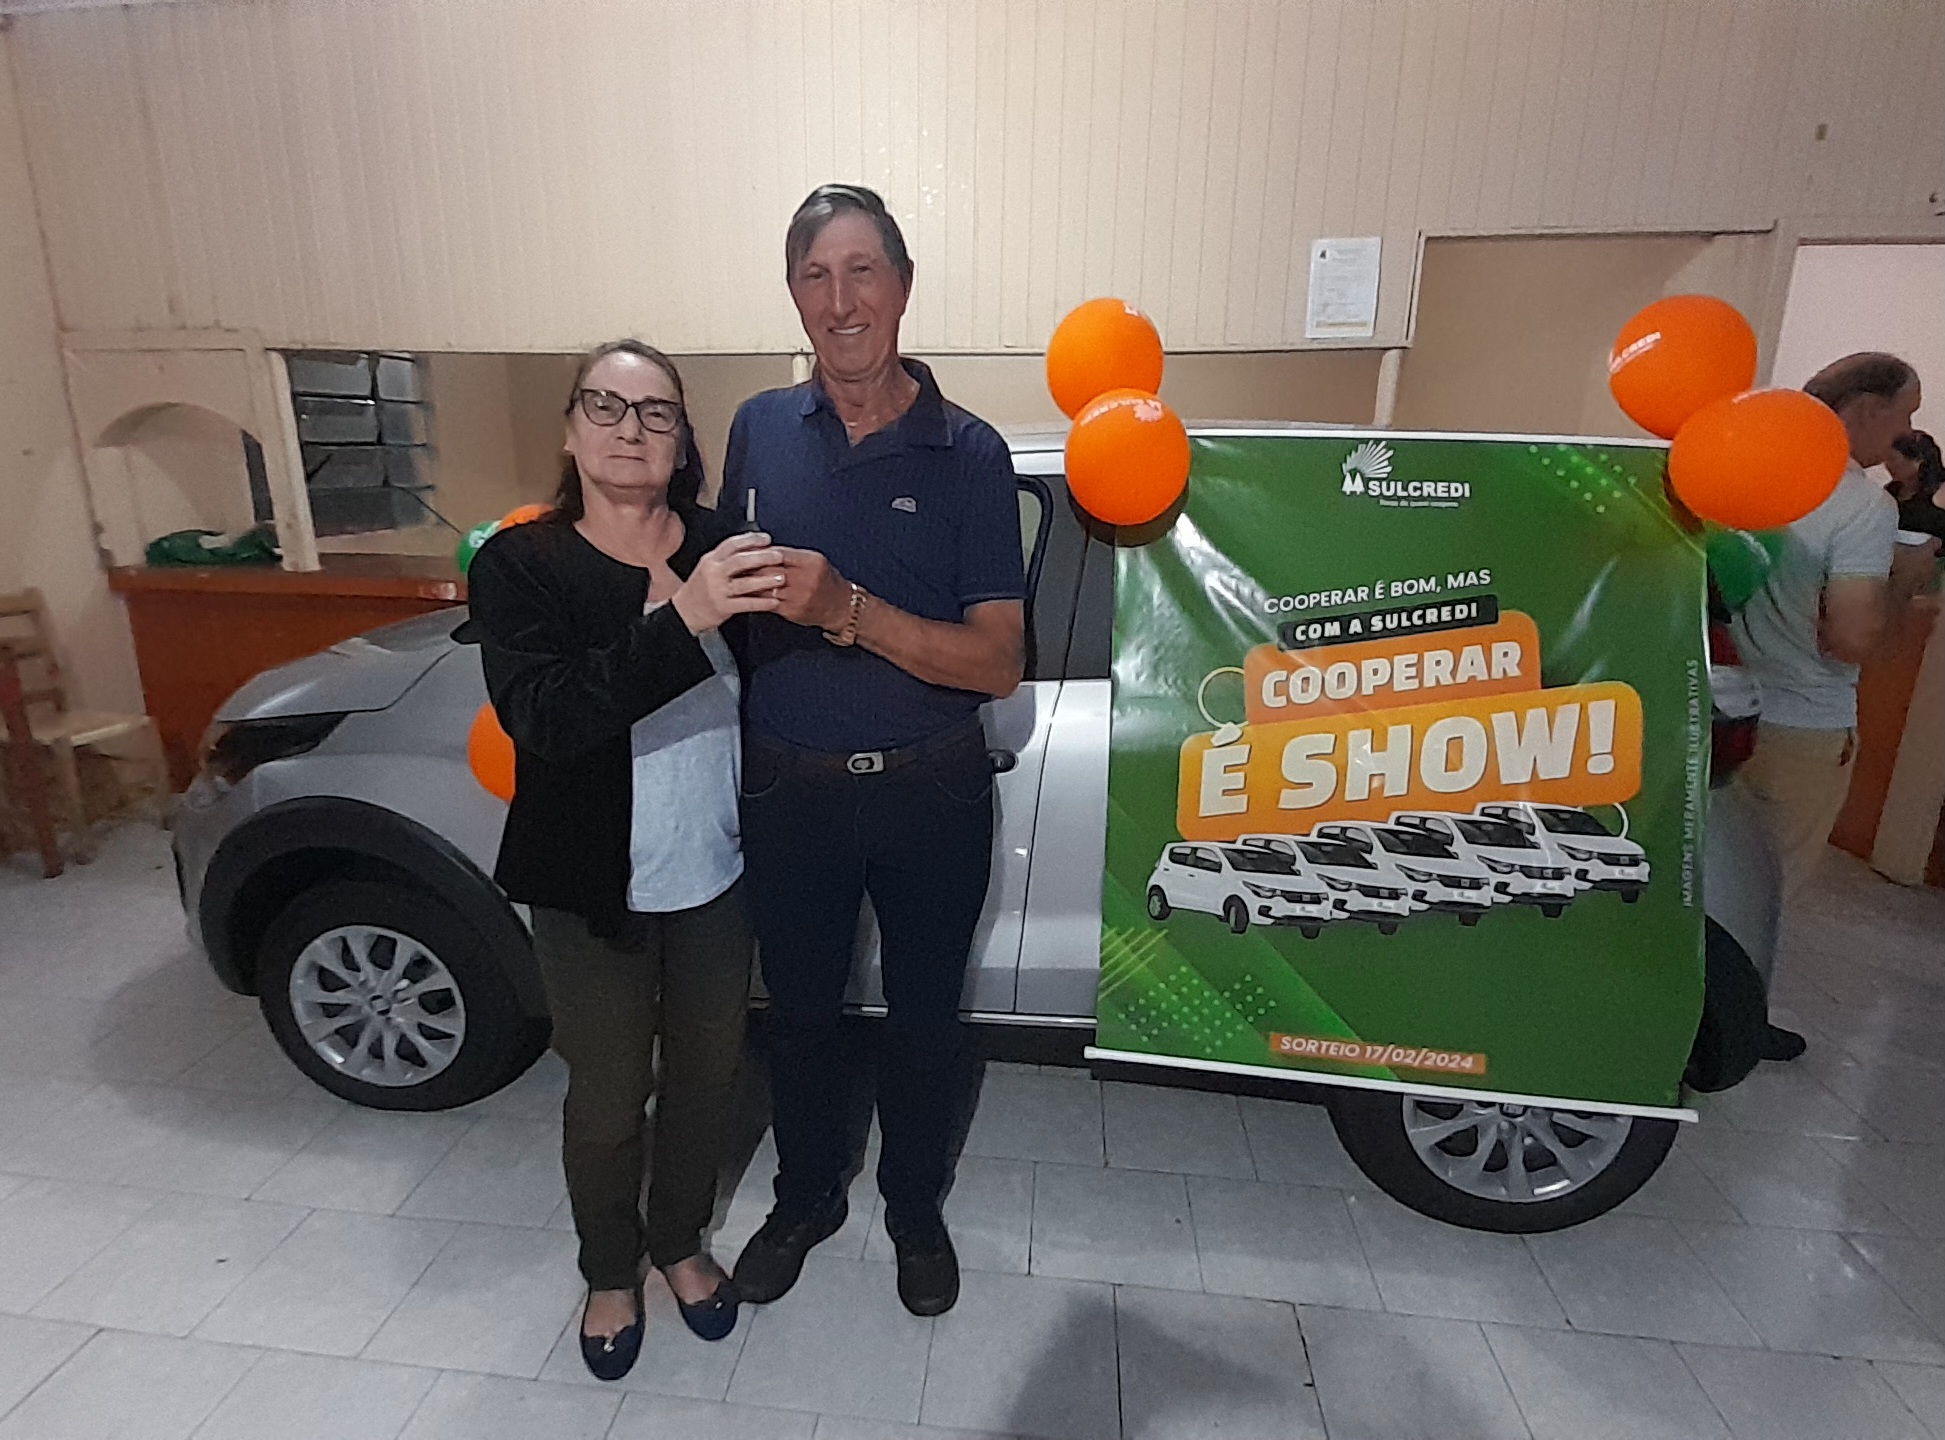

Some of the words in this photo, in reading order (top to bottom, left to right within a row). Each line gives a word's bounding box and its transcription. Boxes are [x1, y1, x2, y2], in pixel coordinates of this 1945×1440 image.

[1367, 480, 1471, 498] SULCREDI
[1264, 586, 1369, 614] COOPERAR
[1374, 580, 1386, 600] É
[1390, 576, 1442, 598] BOM,
[1447, 569, 1491, 590] MAS
[1295, 621, 1341, 642] COM
[1348, 618, 1363, 635] A
[1370, 602, 1478, 632] SULCREDI
[1261, 641, 1522, 709] COOPERAR
[1199, 721, 1251, 818] É
[1278, 699, 1616, 811] SHOW!
[1683, 758, 1699, 840] MERAMENTE
[1682, 844, 1694, 908] IMAGENS
[1280, 1035, 1361, 1058] SORTEIO
[1365, 1043, 1474, 1069] 17/02/2024
